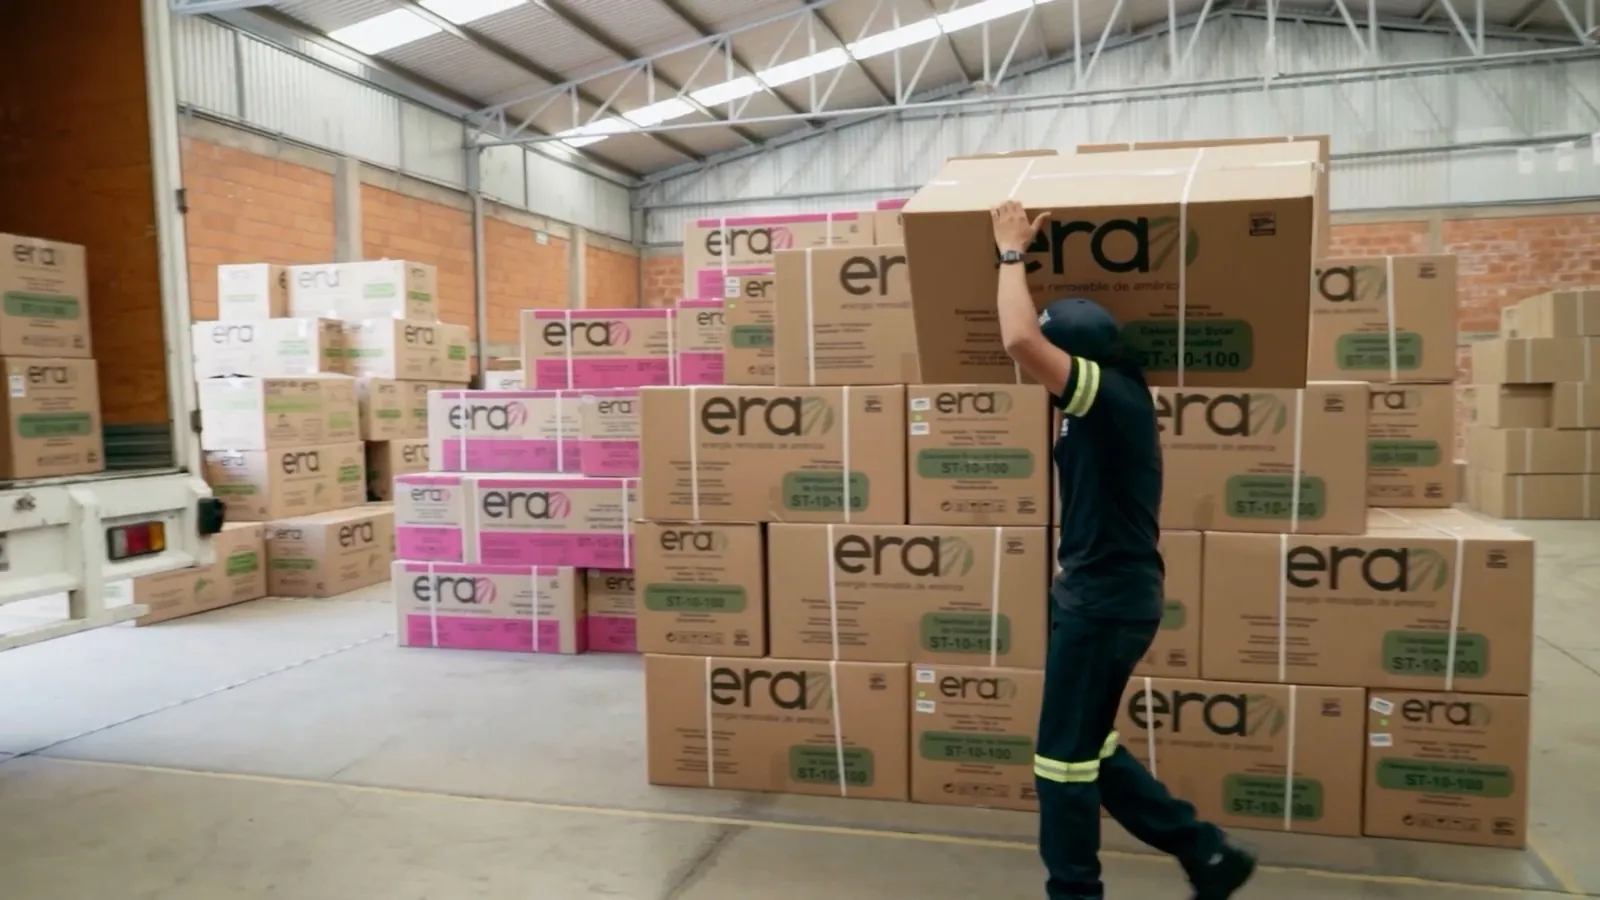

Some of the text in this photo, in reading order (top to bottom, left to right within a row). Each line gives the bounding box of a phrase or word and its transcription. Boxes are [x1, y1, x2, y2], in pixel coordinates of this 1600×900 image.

[14, 243, 57, 266] era
[706, 227, 773, 257] era
[840, 255, 907, 296] er
[745, 280, 773, 297] er
[211, 324, 254, 343] era
[405, 325, 435, 345] era
[543, 320, 611, 347] era
[27, 365, 69, 384] era
[598, 401, 632, 414] era
[936, 391, 994, 414] era
[1369, 390, 1406, 410] ra
[449, 404, 509, 430] era
[701, 396, 802, 437] era
[281, 451, 319, 474] era
[410, 488, 442, 501] era
[483, 491, 550, 519] era
[338, 521, 374, 548] era
[660, 530, 713, 551] era
[834, 534, 940, 577] era
[1286, 545, 1408, 592] era
[413, 575, 477, 604] era
[1391, 657, 1479, 674] ST-10-00
[710, 667, 807, 710] era
[939, 676, 998, 700] era
[1127, 687, 1247, 737] era
[1402, 698, 1470, 726] era
